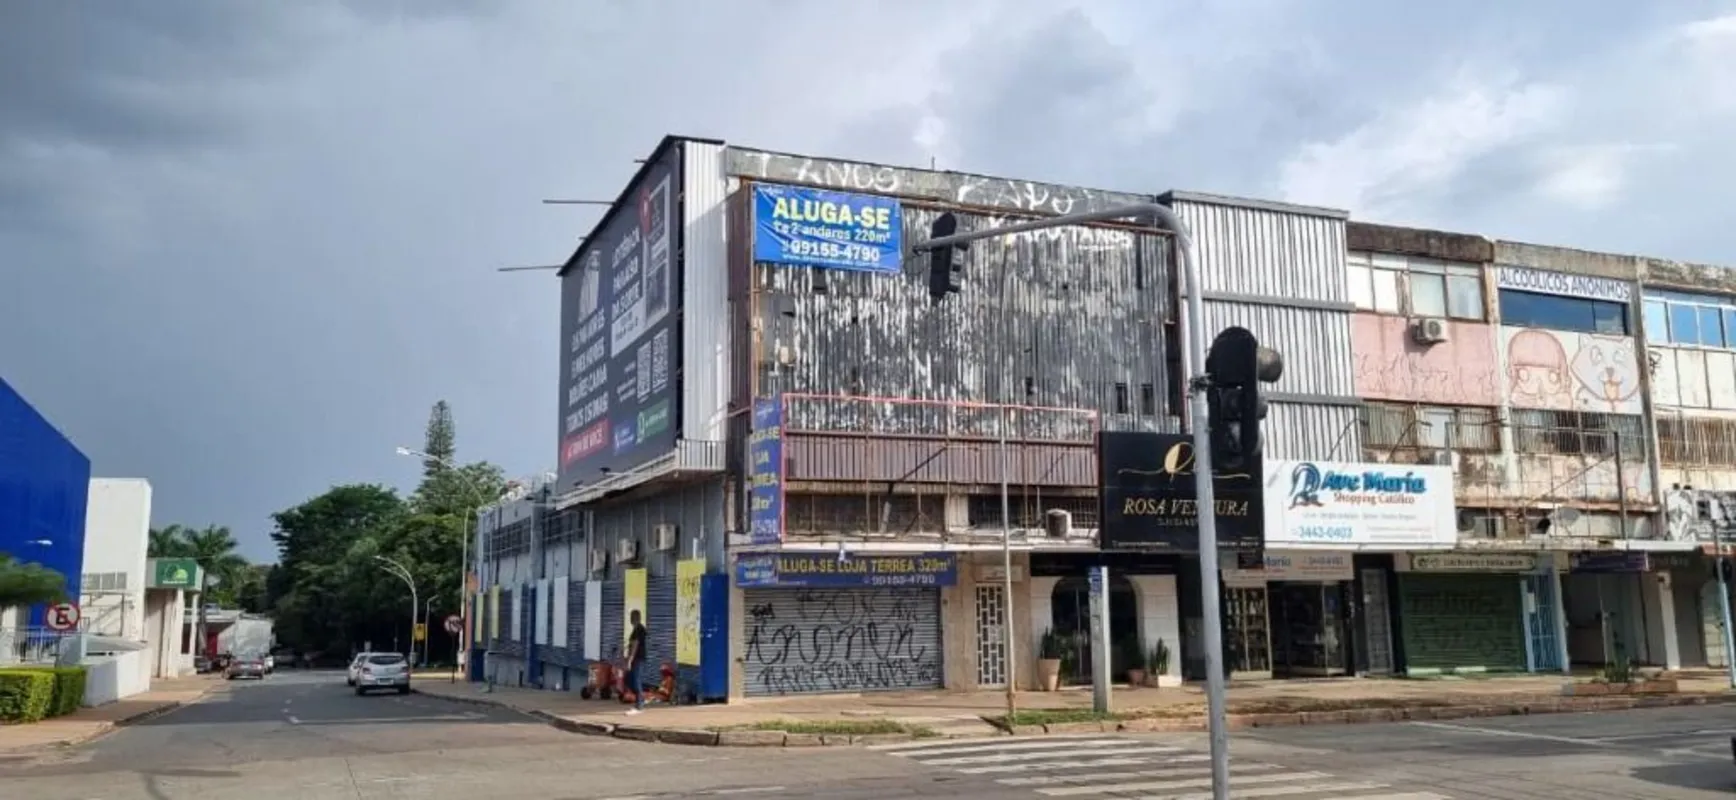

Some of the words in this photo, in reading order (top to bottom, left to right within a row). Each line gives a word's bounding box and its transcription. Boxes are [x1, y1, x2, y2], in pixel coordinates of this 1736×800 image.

[772, 197, 890, 230] ALUGA-SE
[1321, 470, 1361, 491] Ave
[1123, 497, 1167, 516] ROSA
[1171, 497, 1250, 516] VEURA
[1333, 493, 1377, 506] Shopping
